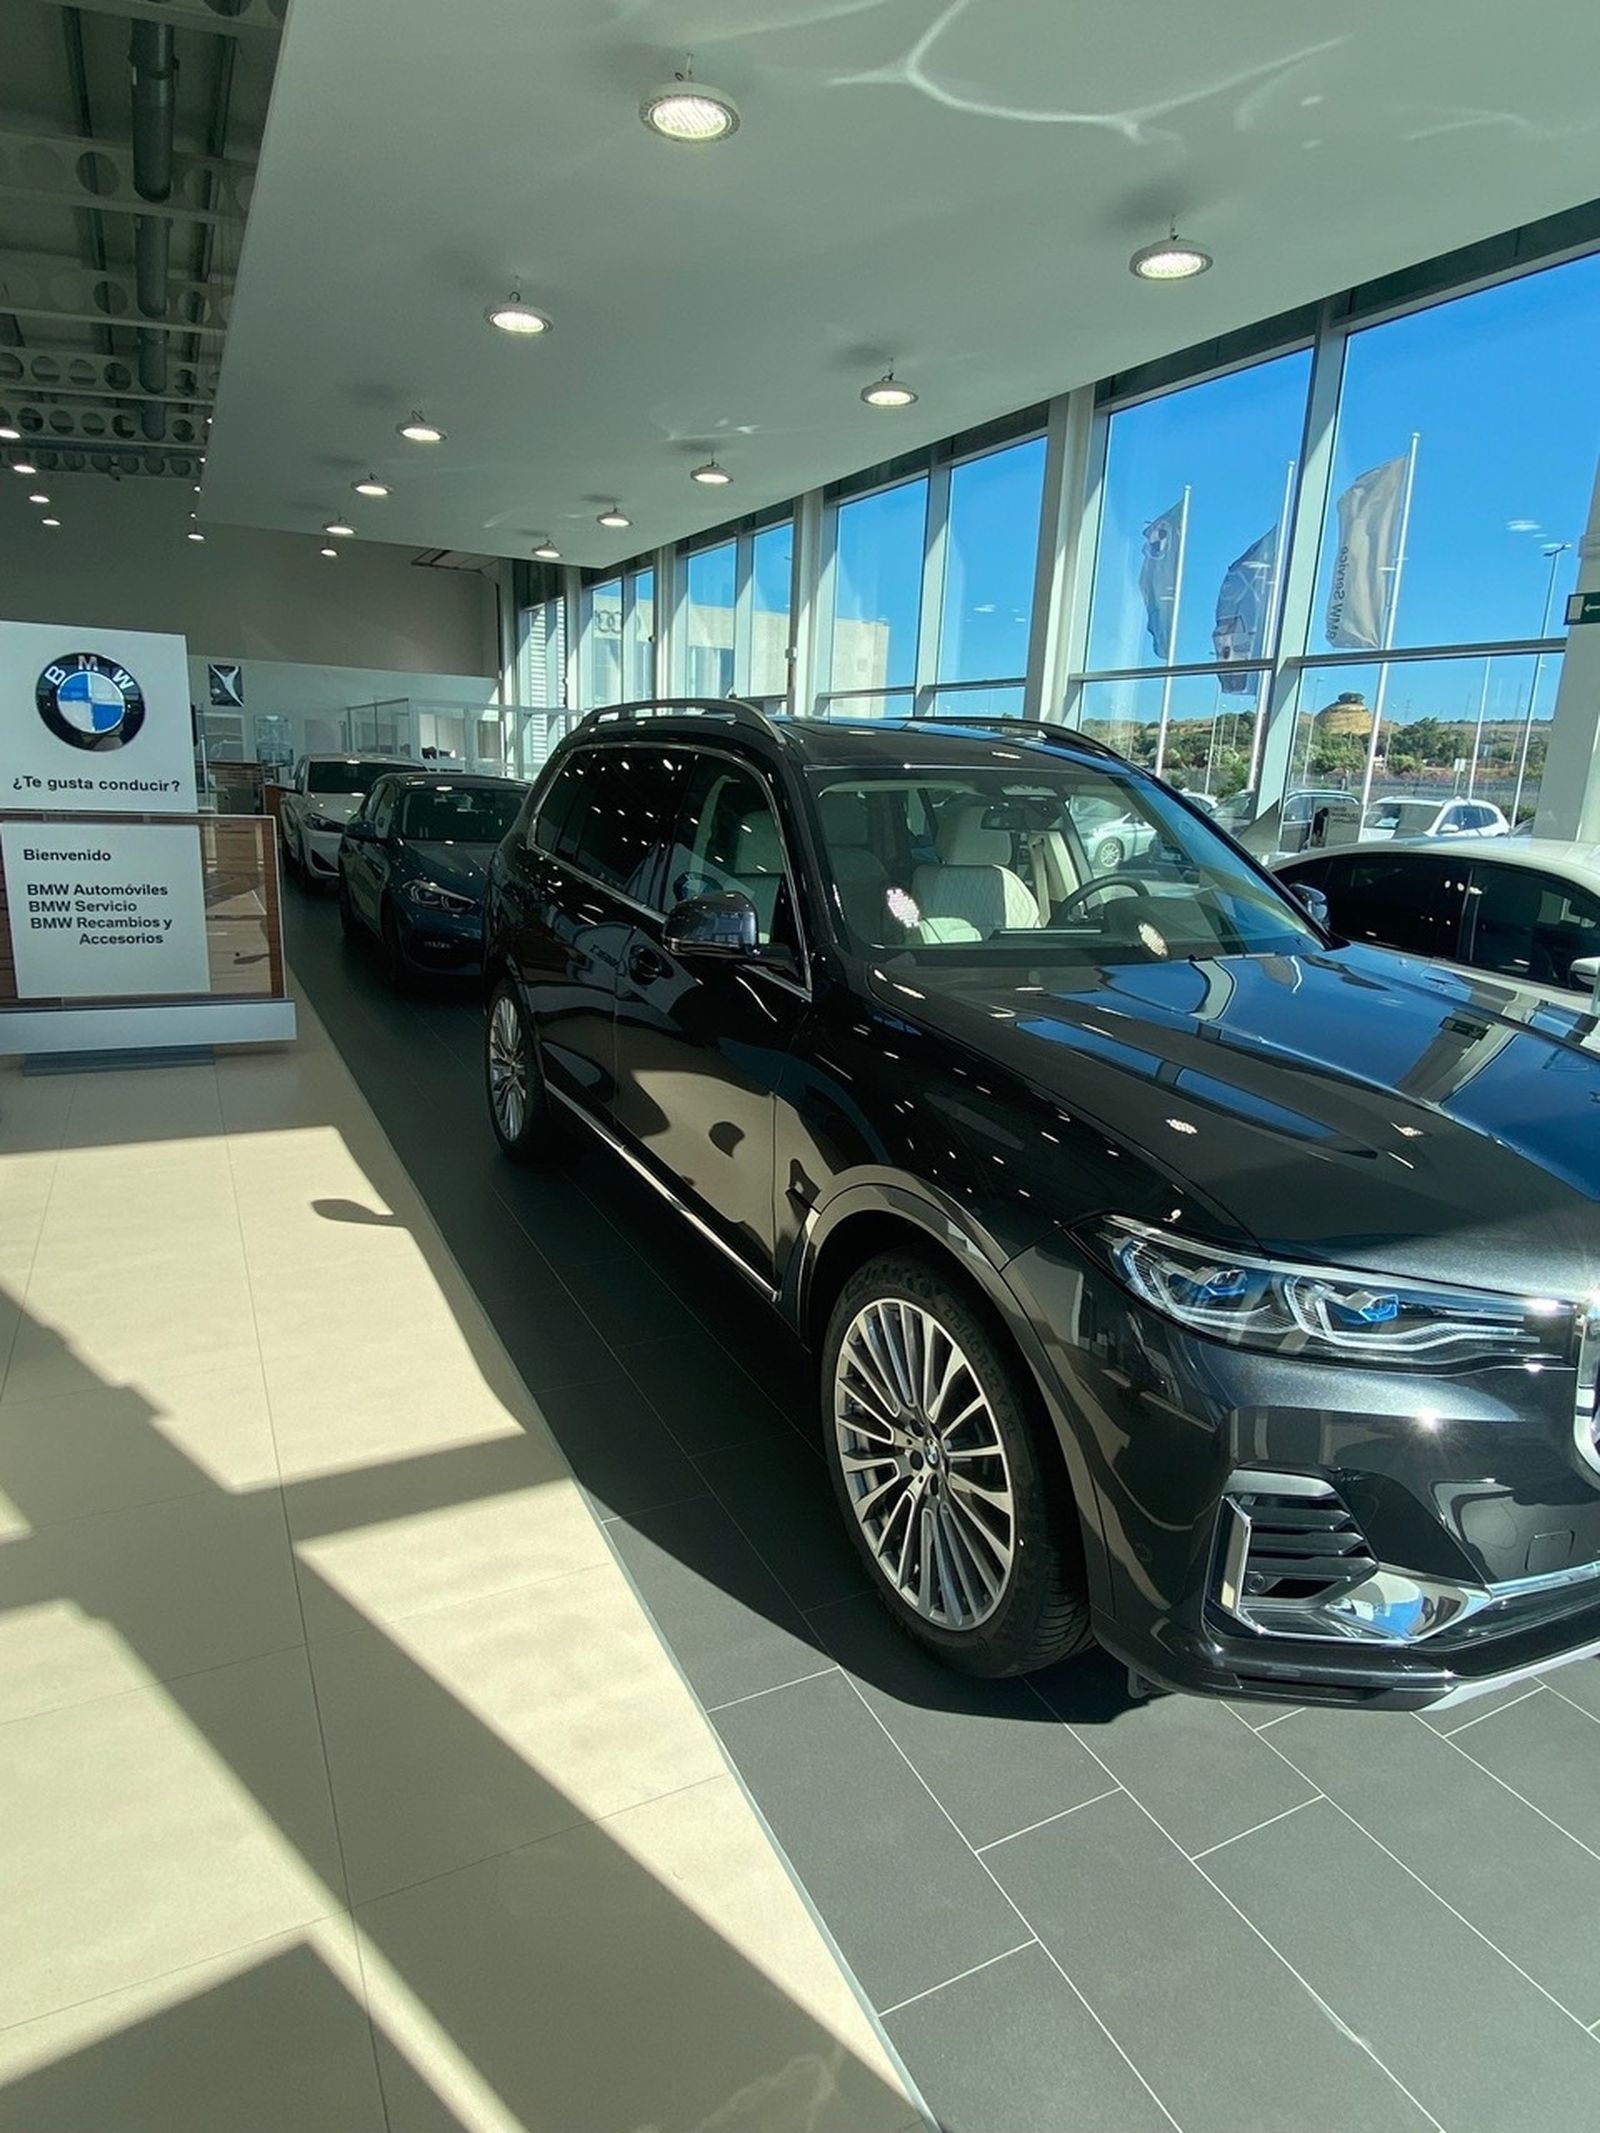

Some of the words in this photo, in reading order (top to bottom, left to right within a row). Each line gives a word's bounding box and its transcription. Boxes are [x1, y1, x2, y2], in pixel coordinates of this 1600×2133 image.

[44, 655, 135, 690] BMW
[13, 776, 42, 790] ¿Te
[48, 777, 93, 791] gusta
[98, 779, 181, 792] conducir?
[23, 848, 112, 861] Bienvenido
[27, 883, 69, 896] BMW
[73, 883, 168, 896] Automóviles
[29, 900, 71, 912] BMW
[75, 900, 137, 912] Servicio
[30, 917, 73, 929] BMW
[76, 916, 160, 929] Recambios
[163, 918, 173, 930] y
[79, 932, 164, 945] Accesorios
